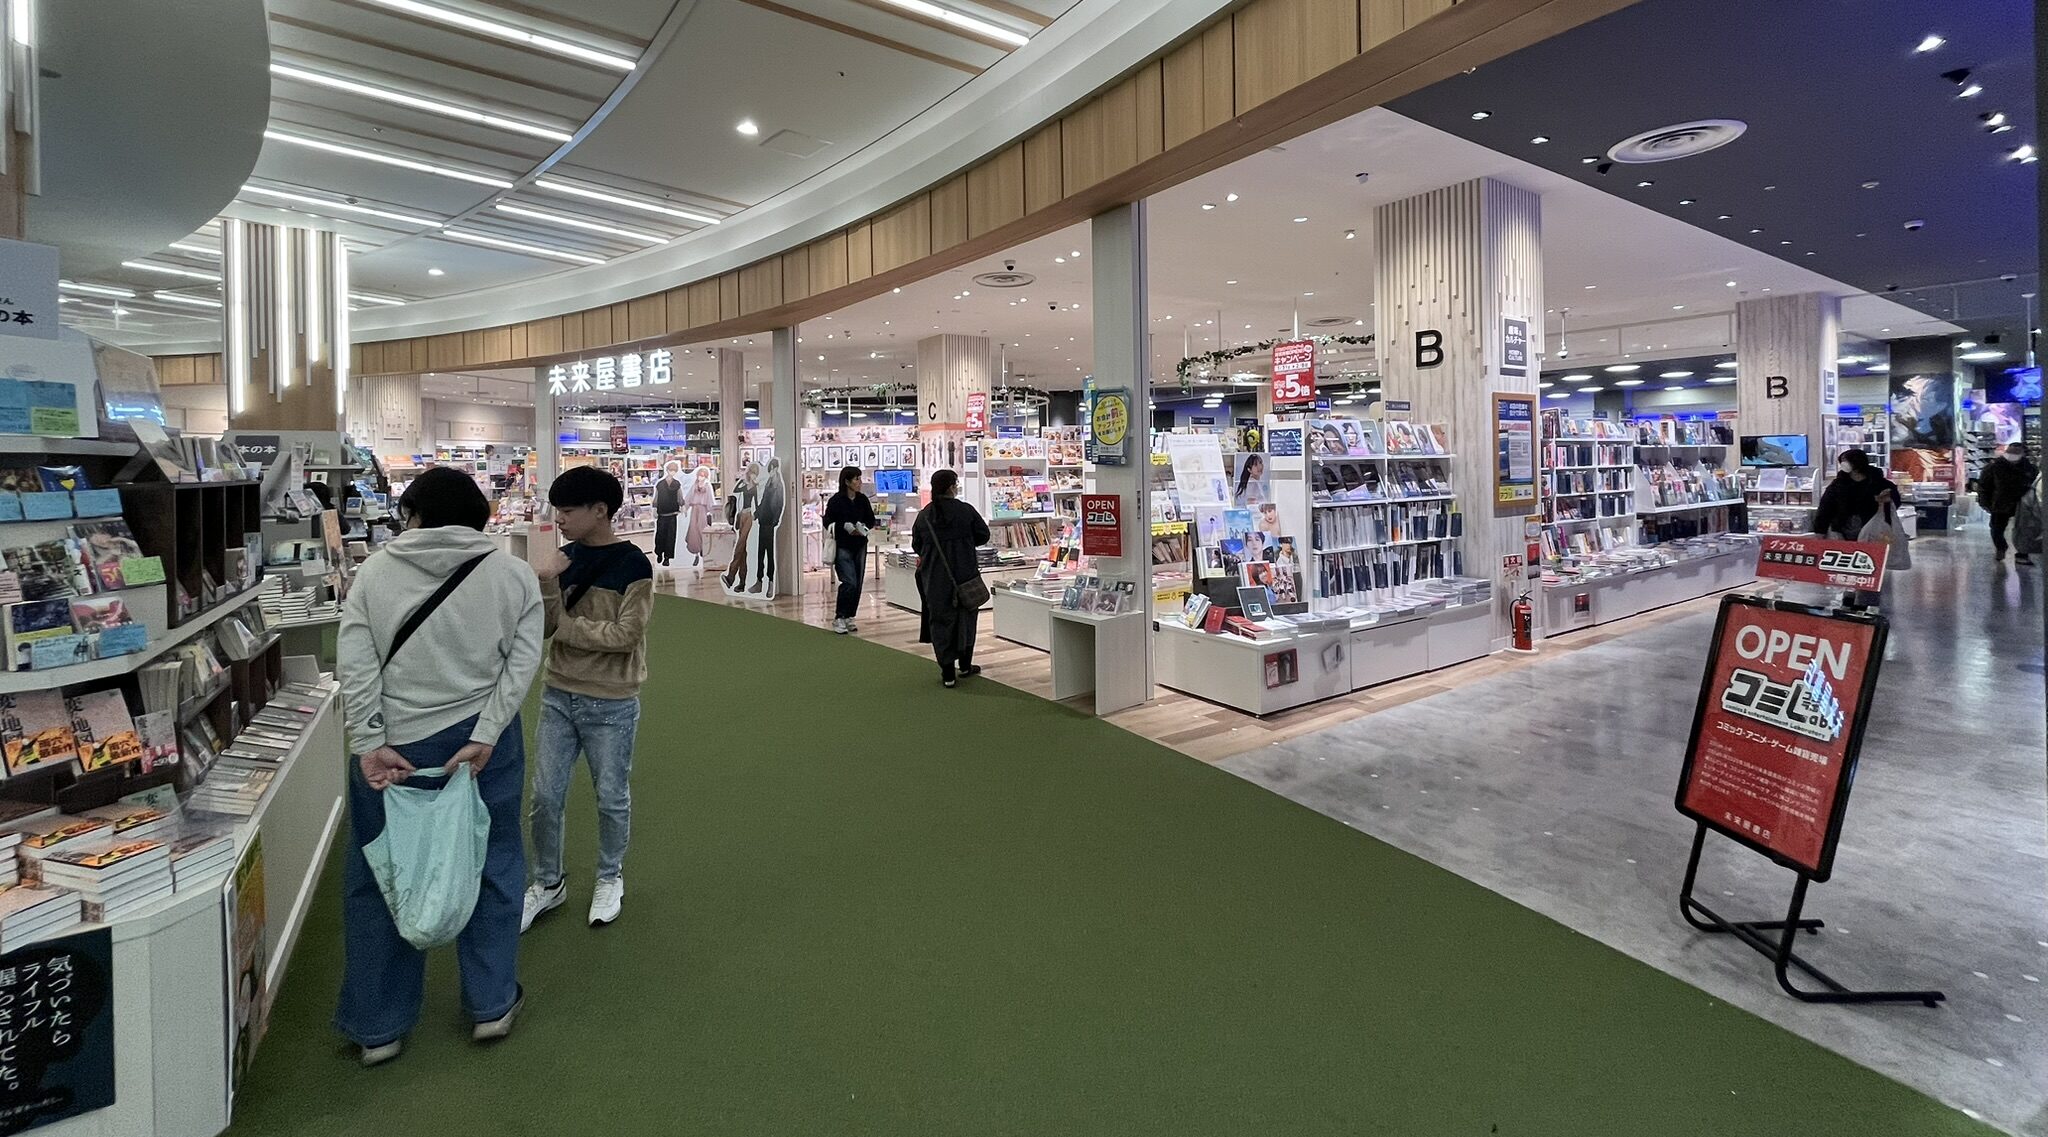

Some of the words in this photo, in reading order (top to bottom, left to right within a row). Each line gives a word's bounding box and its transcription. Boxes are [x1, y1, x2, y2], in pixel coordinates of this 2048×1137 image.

[1274, 352, 1312, 364] キャンペーン
[1416, 330, 1444, 367] B
[548, 348, 673, 397] 未来屋書店
[1766, 376, 1789, 399] B
[928, 402, 937, 420] C
[1087, 500, 1115, 510] OPEN
[1770, 539, 1805, 551] グッズは
[1763, 552, 1815, 565] 未来屋書店
[1735, 624, 1852, 681] OPEN
[20, 962, 47, 1033] ライフル
[47, 954, 74, 1047] 気づいたら
